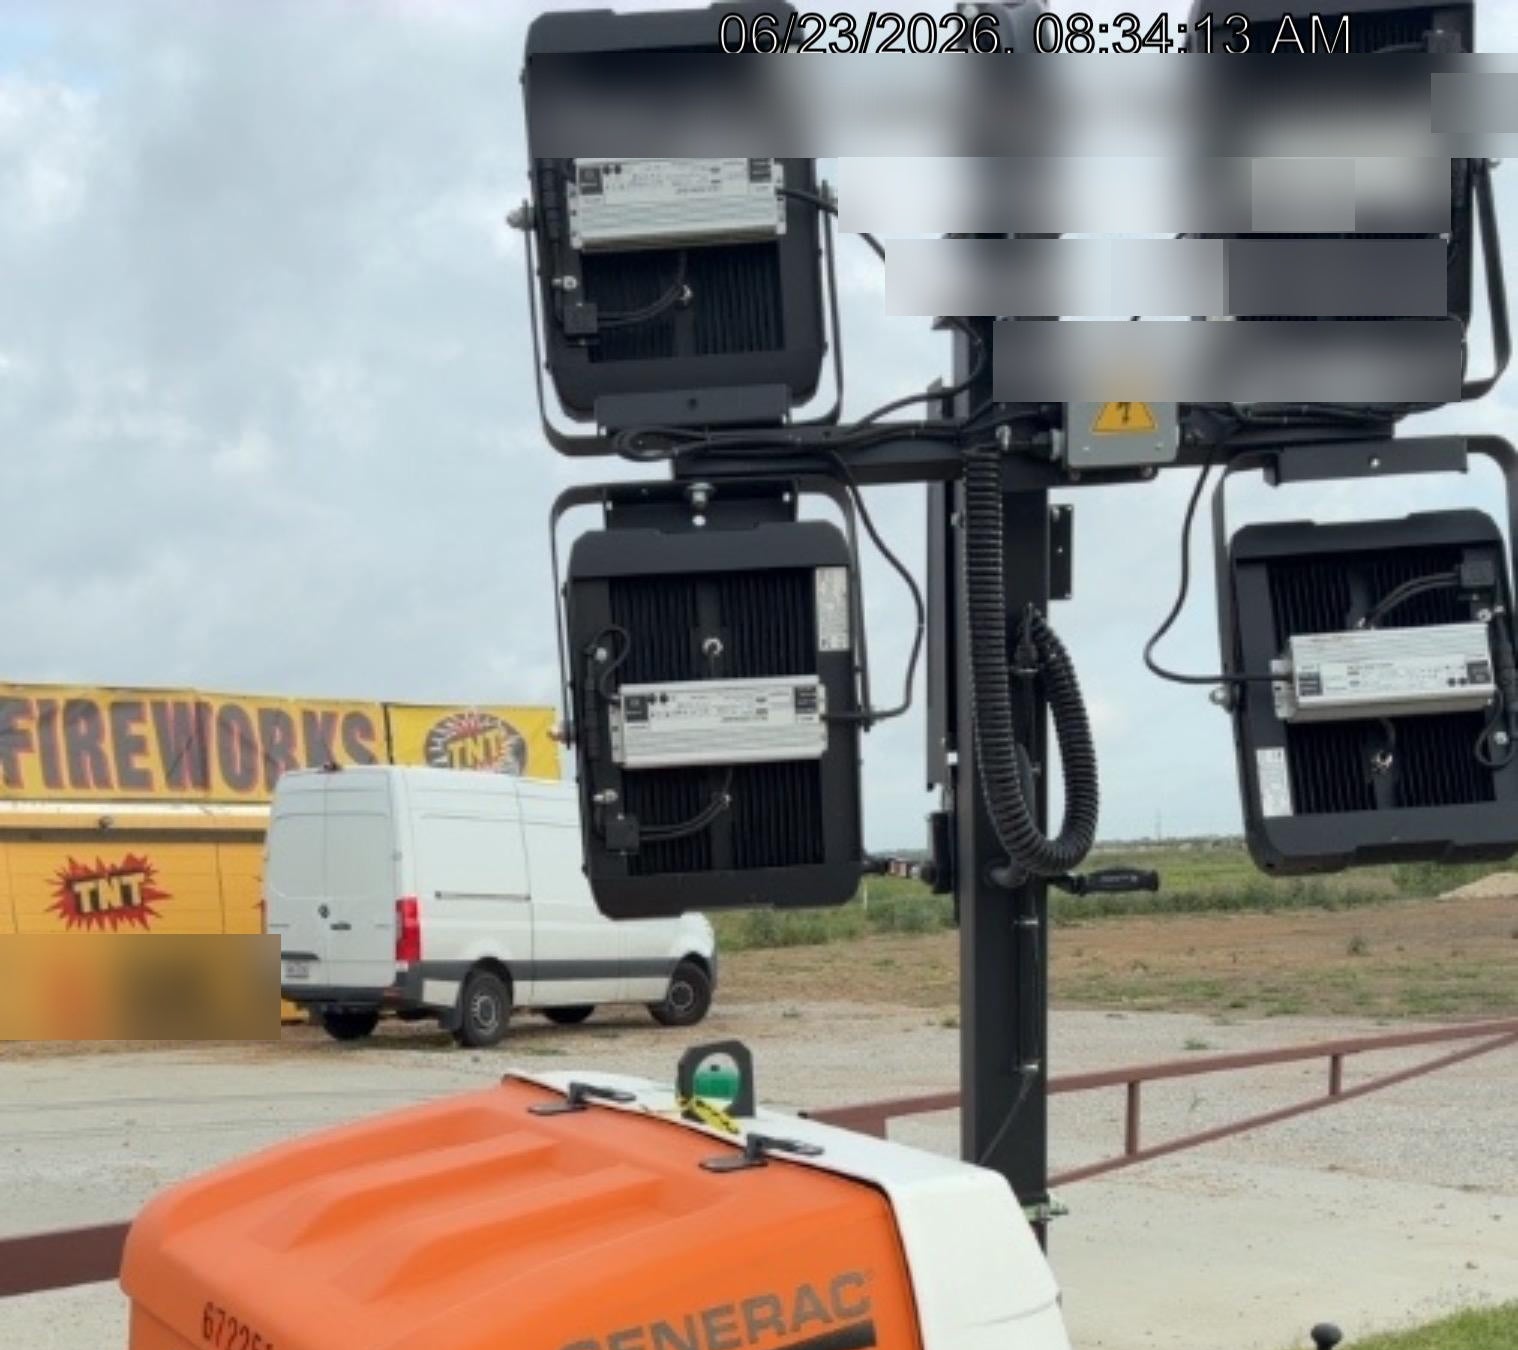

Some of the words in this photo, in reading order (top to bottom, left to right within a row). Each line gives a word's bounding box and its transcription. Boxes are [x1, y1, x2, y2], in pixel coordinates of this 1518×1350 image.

[0, 694, 378, 793] FIREWORKS
[446, 728, 503, 769] TNT
[73, 872, 146, 914] TNT
